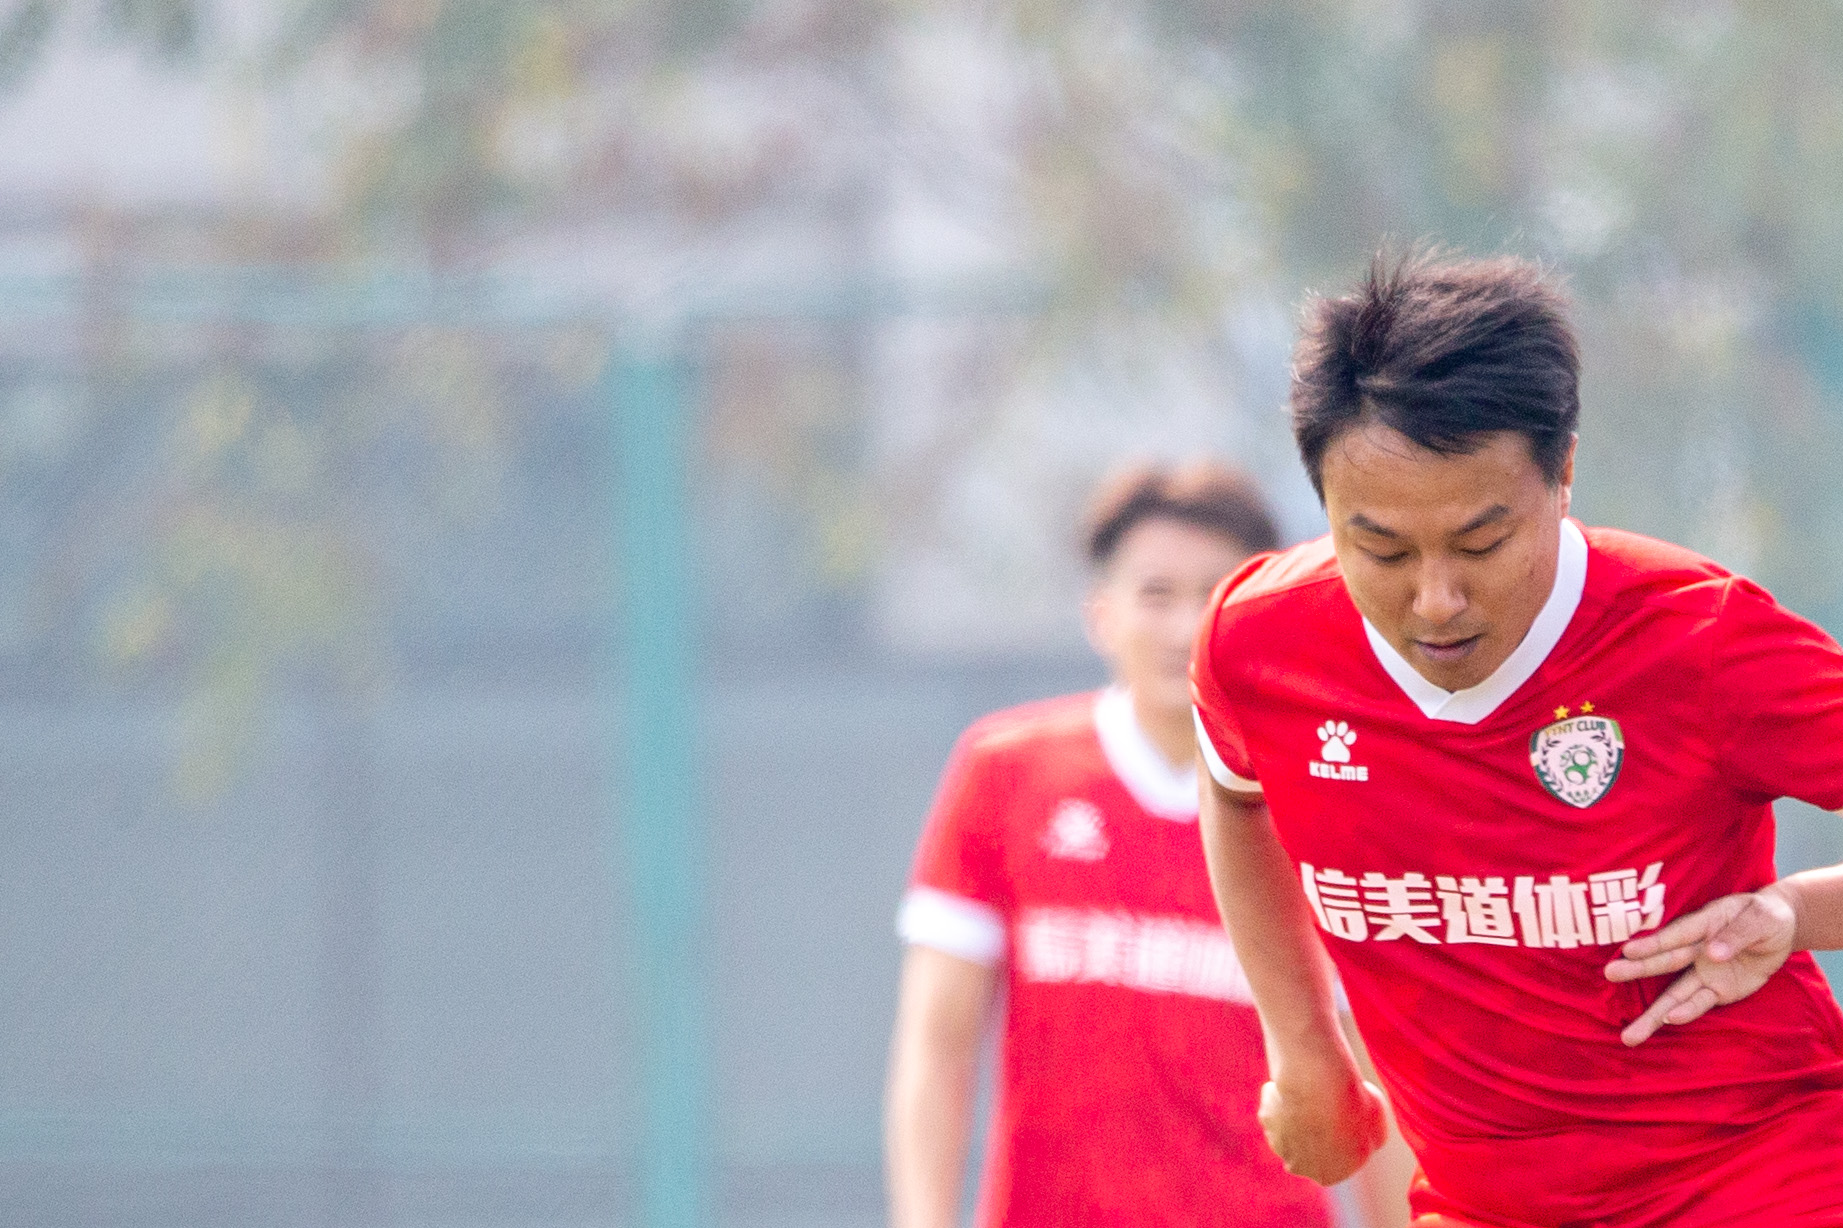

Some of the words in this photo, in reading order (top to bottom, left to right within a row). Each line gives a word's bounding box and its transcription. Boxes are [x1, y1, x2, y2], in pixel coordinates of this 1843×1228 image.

[1308, 760, 1369, 782] KELME
[1300, 861, 1666, 949] 信美道体彩
